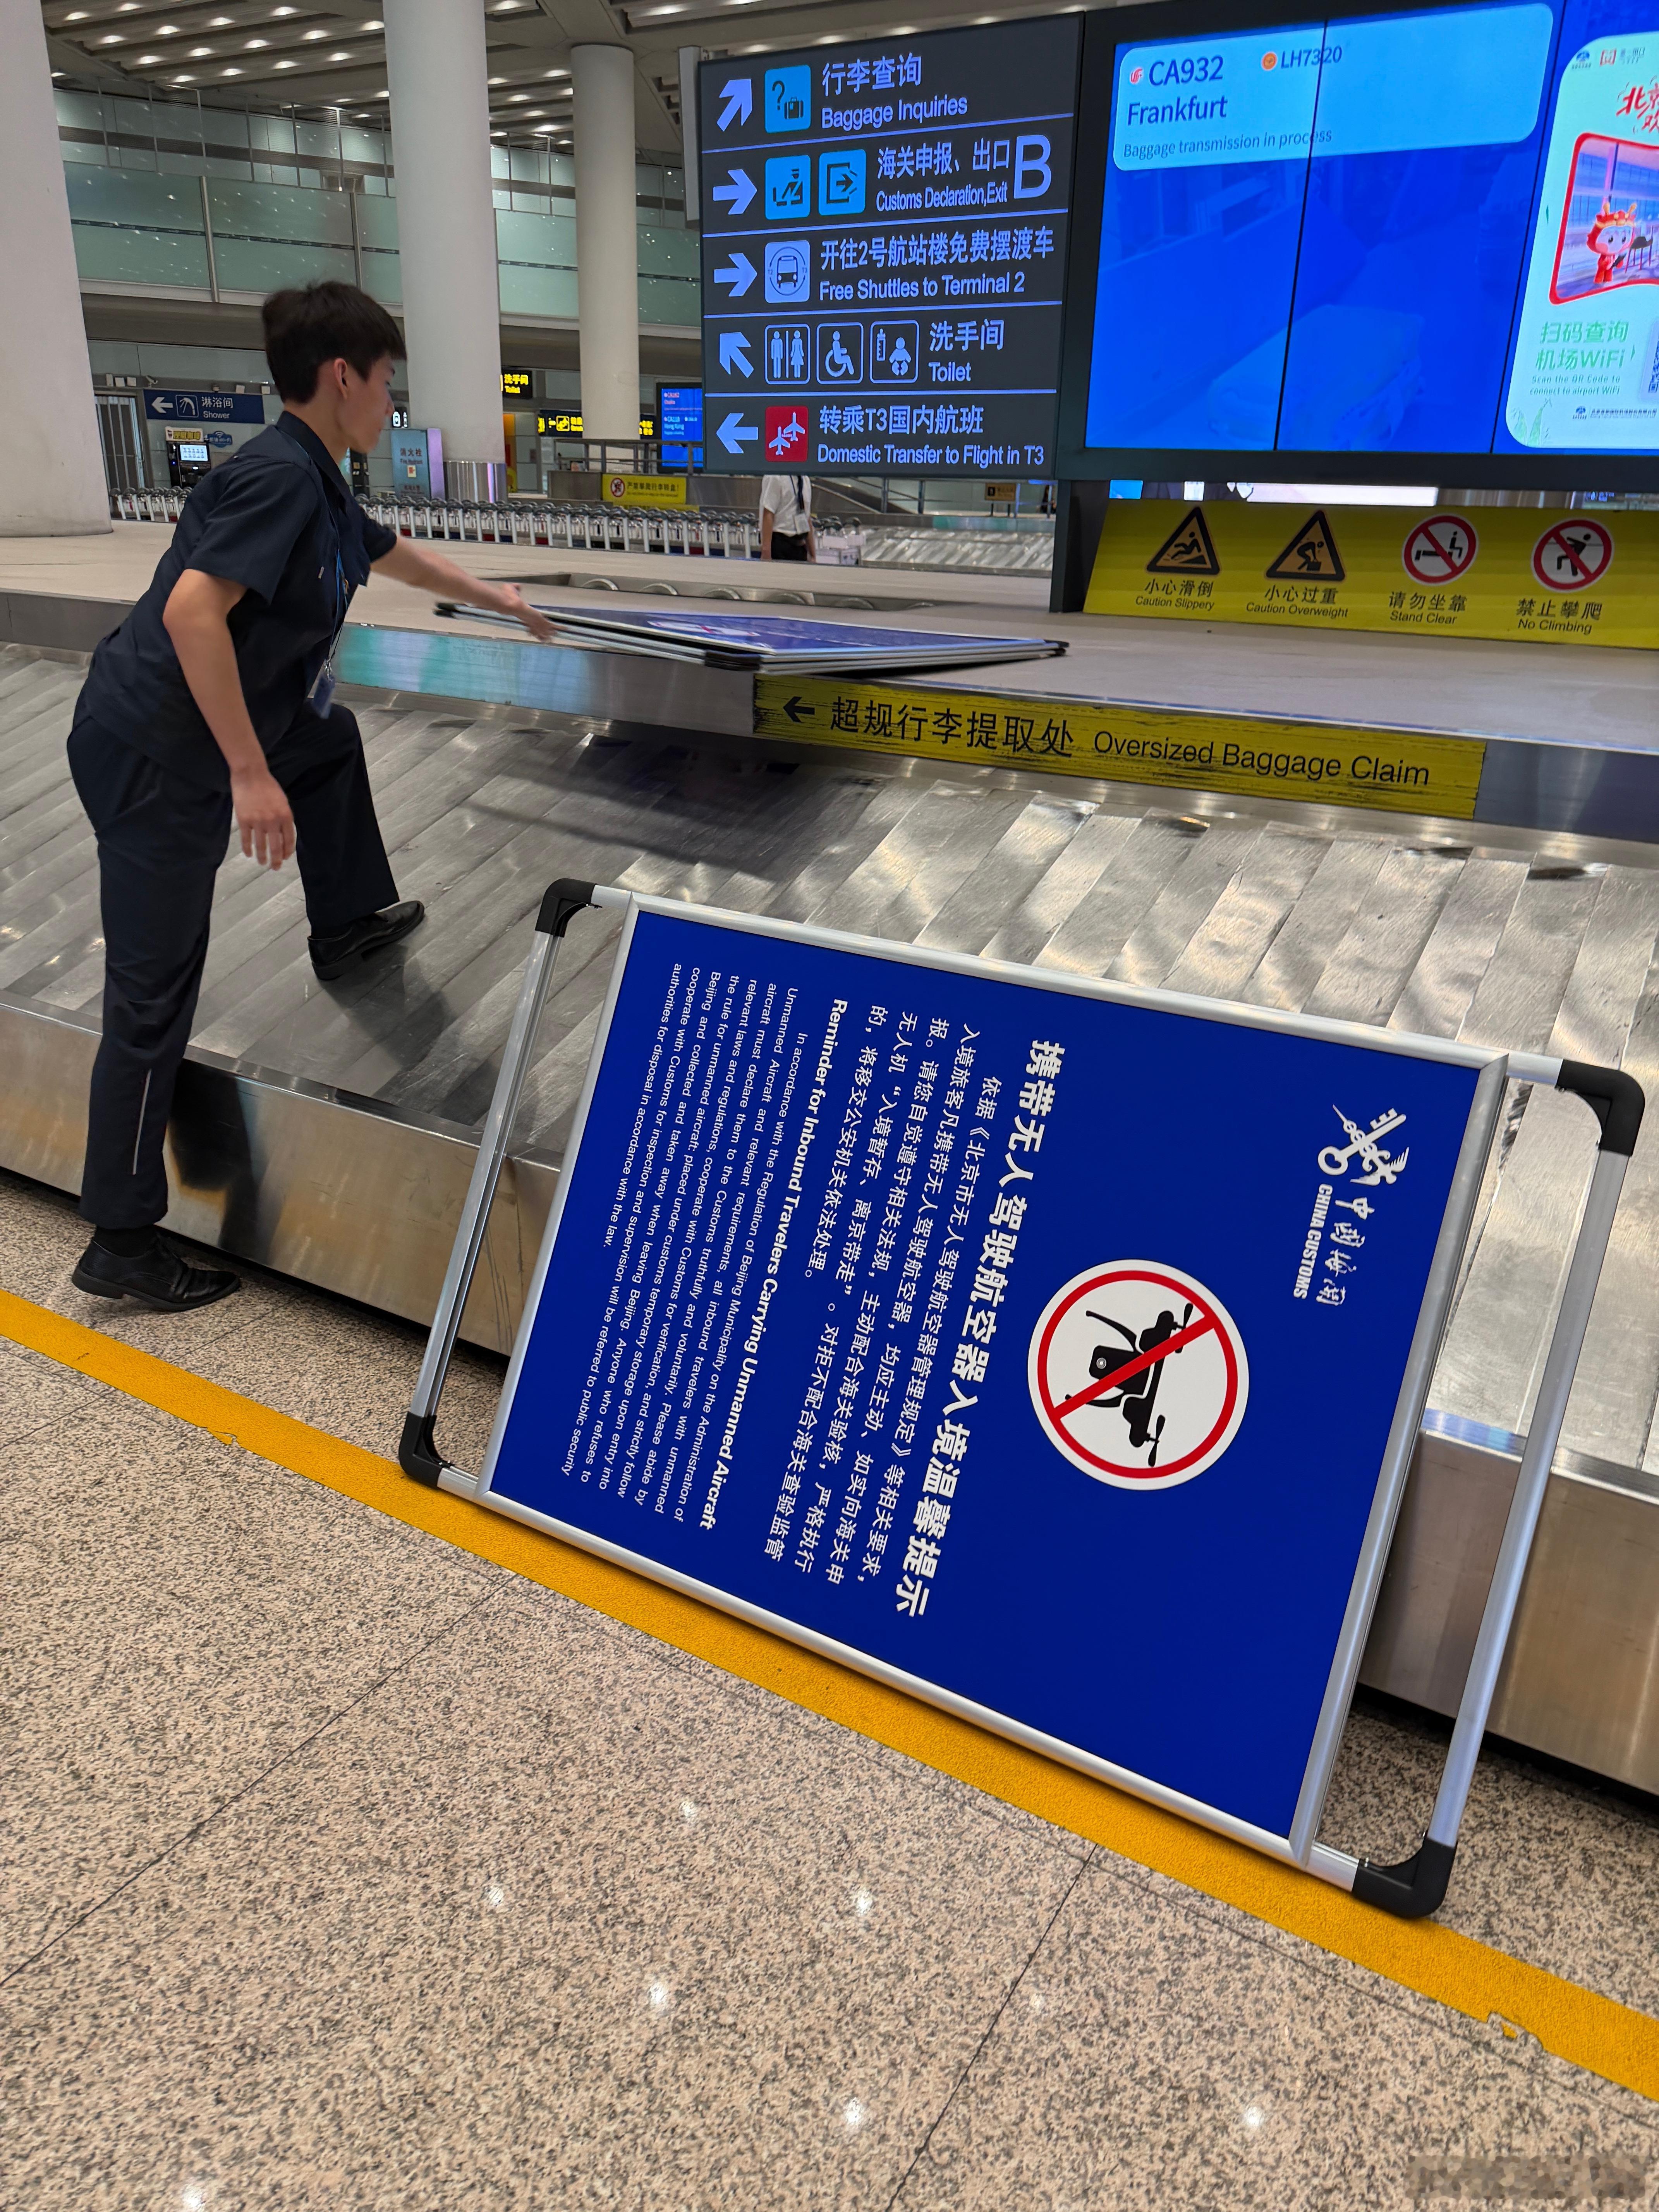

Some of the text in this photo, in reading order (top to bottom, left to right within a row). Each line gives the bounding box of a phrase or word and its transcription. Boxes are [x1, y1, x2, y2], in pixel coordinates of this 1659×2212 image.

[821, 52, 922, 97] 行李查询
[1149, 45, 1342, 86] CA932 LH7320
[821, 95, 968, 131] Baggage Inquiries
[1127, 95, 1228, 126] Frankfurt
[877, 138, 1010, 180] 海关申报、出口
[1124, 142, 1175, 160] Baggage
[1179, 132, 1260, 153] transmission
[1264, 131, 1276, 147] in
[1013, 134, 1051, 199] B
[876, 189, 922, 212] Customs
[820, 226, 1054, 270] 开往2号航站楼免费摆渡车
[820, 272, 1025, 301] Free Shuttles to Terminal 2
[929, 319, 1005, 352] 洗手间
[1540, 320, 1629, 344] 扫码查询
[928, 362, 971, 382] Toilet
[1535, 348, 1625, 371] 机场WiFi
[201, 397, 233, 408] 淋浴间
[819, 405, 984, 435] 转乘T3国内航班
[817, 444, 1044, 469] Domestic Transfer to Flight in T3
[1135, 596, 1214, 611] Caution Slippery
[1144, 579, 1214, 598] 小心滑倒
[1264, 585, 1339, 605] 小心过重
[1389, 591, 1467, 612] 请勿坐靠
[1246, 603, 1348, 618] Caution Overweight
[1390, 610, 1457, 624] Stand Clear
[1516, 598, 1602, 621] 禁止攀爬
[1518, 619, 1592, 635] No Climbing
[830, 696, 1074, 757] 超规行李提取处
[1094, 731, 1430, 786] Oversized Baggage Claim
[603, 963, 682, 1247] authorities for disposal in accordance with the law.
[599, 975, 739, 1490] the rule for unmanned aircraft: placed under customs temporary storage upon entry into
[617, 979, 757, 1498] relevant laws and regulations, cooperate with Customs for verification, and strictly follow
[634, 982, 777, 1506] aircraft must declare them to the Customs truthfully and voluntarily. Please abide by
[1293, 1183, 1333, 1299] CHINA CUSTOMS
[654, 988, 798, 1514] Unmanned Aircraft and relevant requirements, all inbound travelers with unmanned
[699, 998, 848, 1530] Reminder for Inbound Travelers Carrying Unmanned Aircraft
[673, 1032, 808, 1522] In accordance with the Regulation of Beijing Municipality on the Administration of
[896, 1039, 1065, 1617] 携带无人驾驶航空器入境温馨提示
